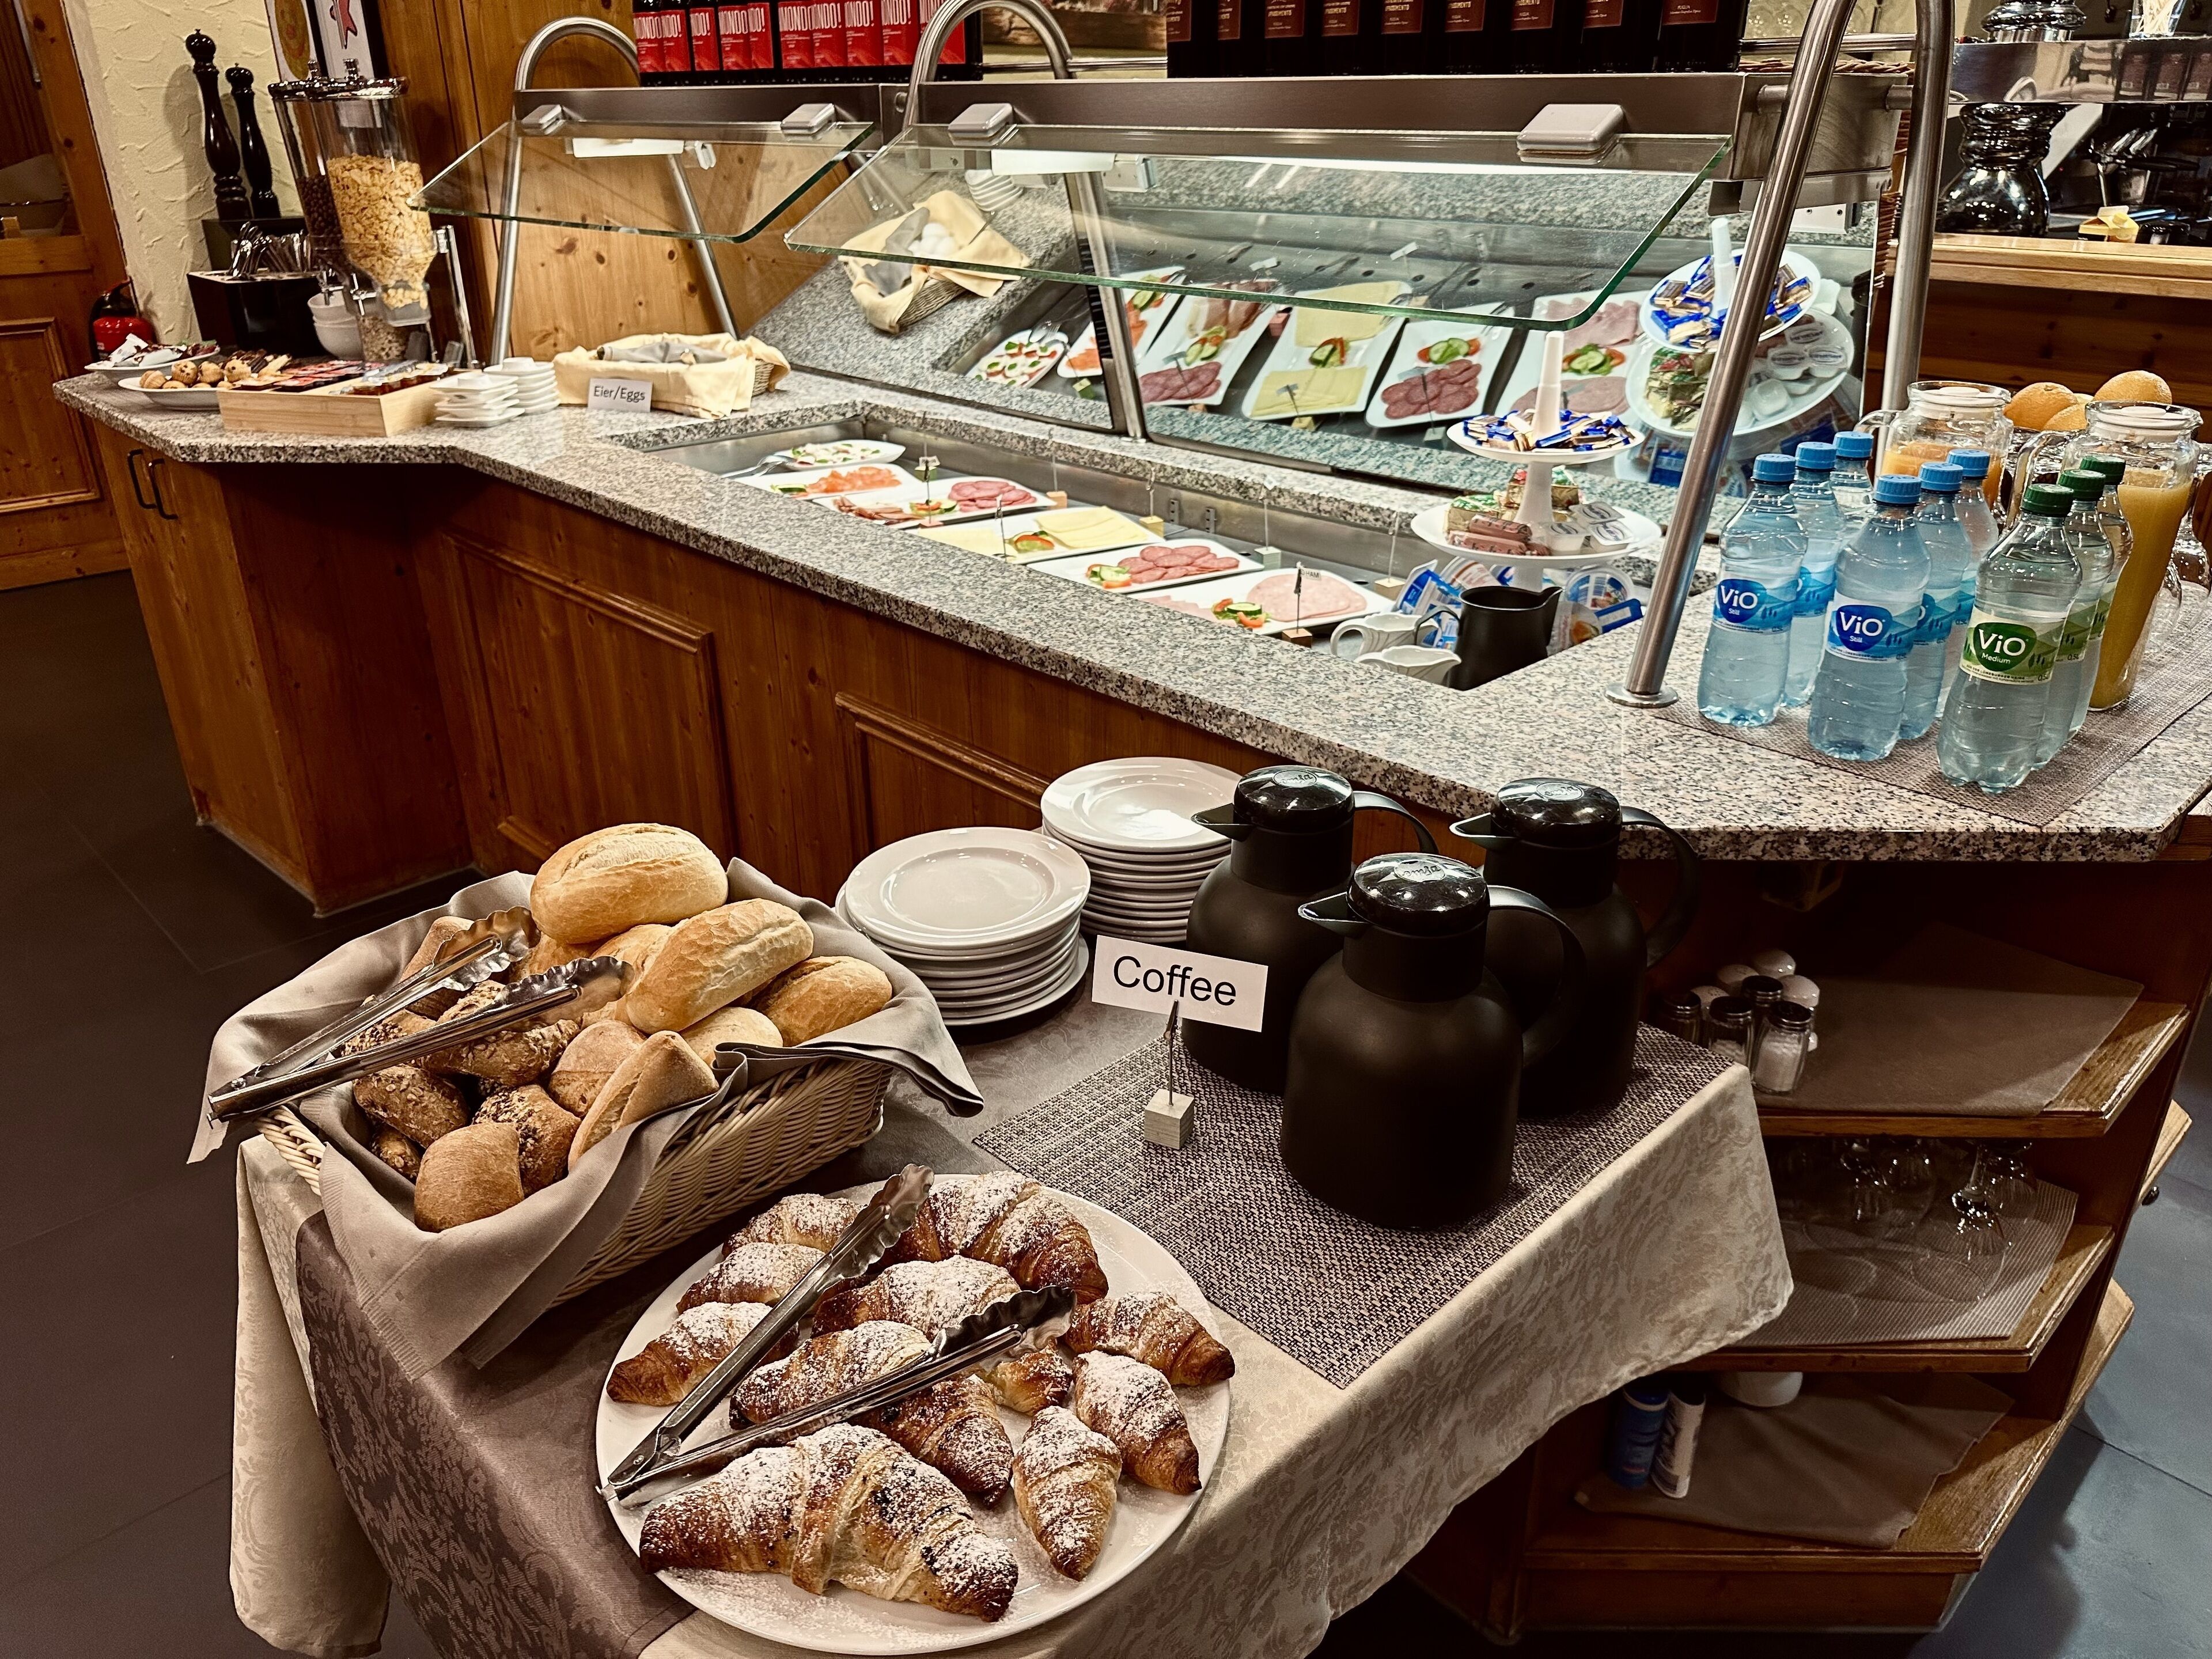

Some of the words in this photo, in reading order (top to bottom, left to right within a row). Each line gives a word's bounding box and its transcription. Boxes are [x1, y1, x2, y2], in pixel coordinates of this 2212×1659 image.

[594, 385, 645, 403] Eier/Eggs
[1721, 585, 1758, 609] ViO
[1840, 611, 1883, 637] ViO
[1849, 635, 1863, 643] Still
[1979, 629, 2026, 656] ViO
[1982, 652, 2011, 665] Medium
[1113, 956, 1236, 1006] Coffee
